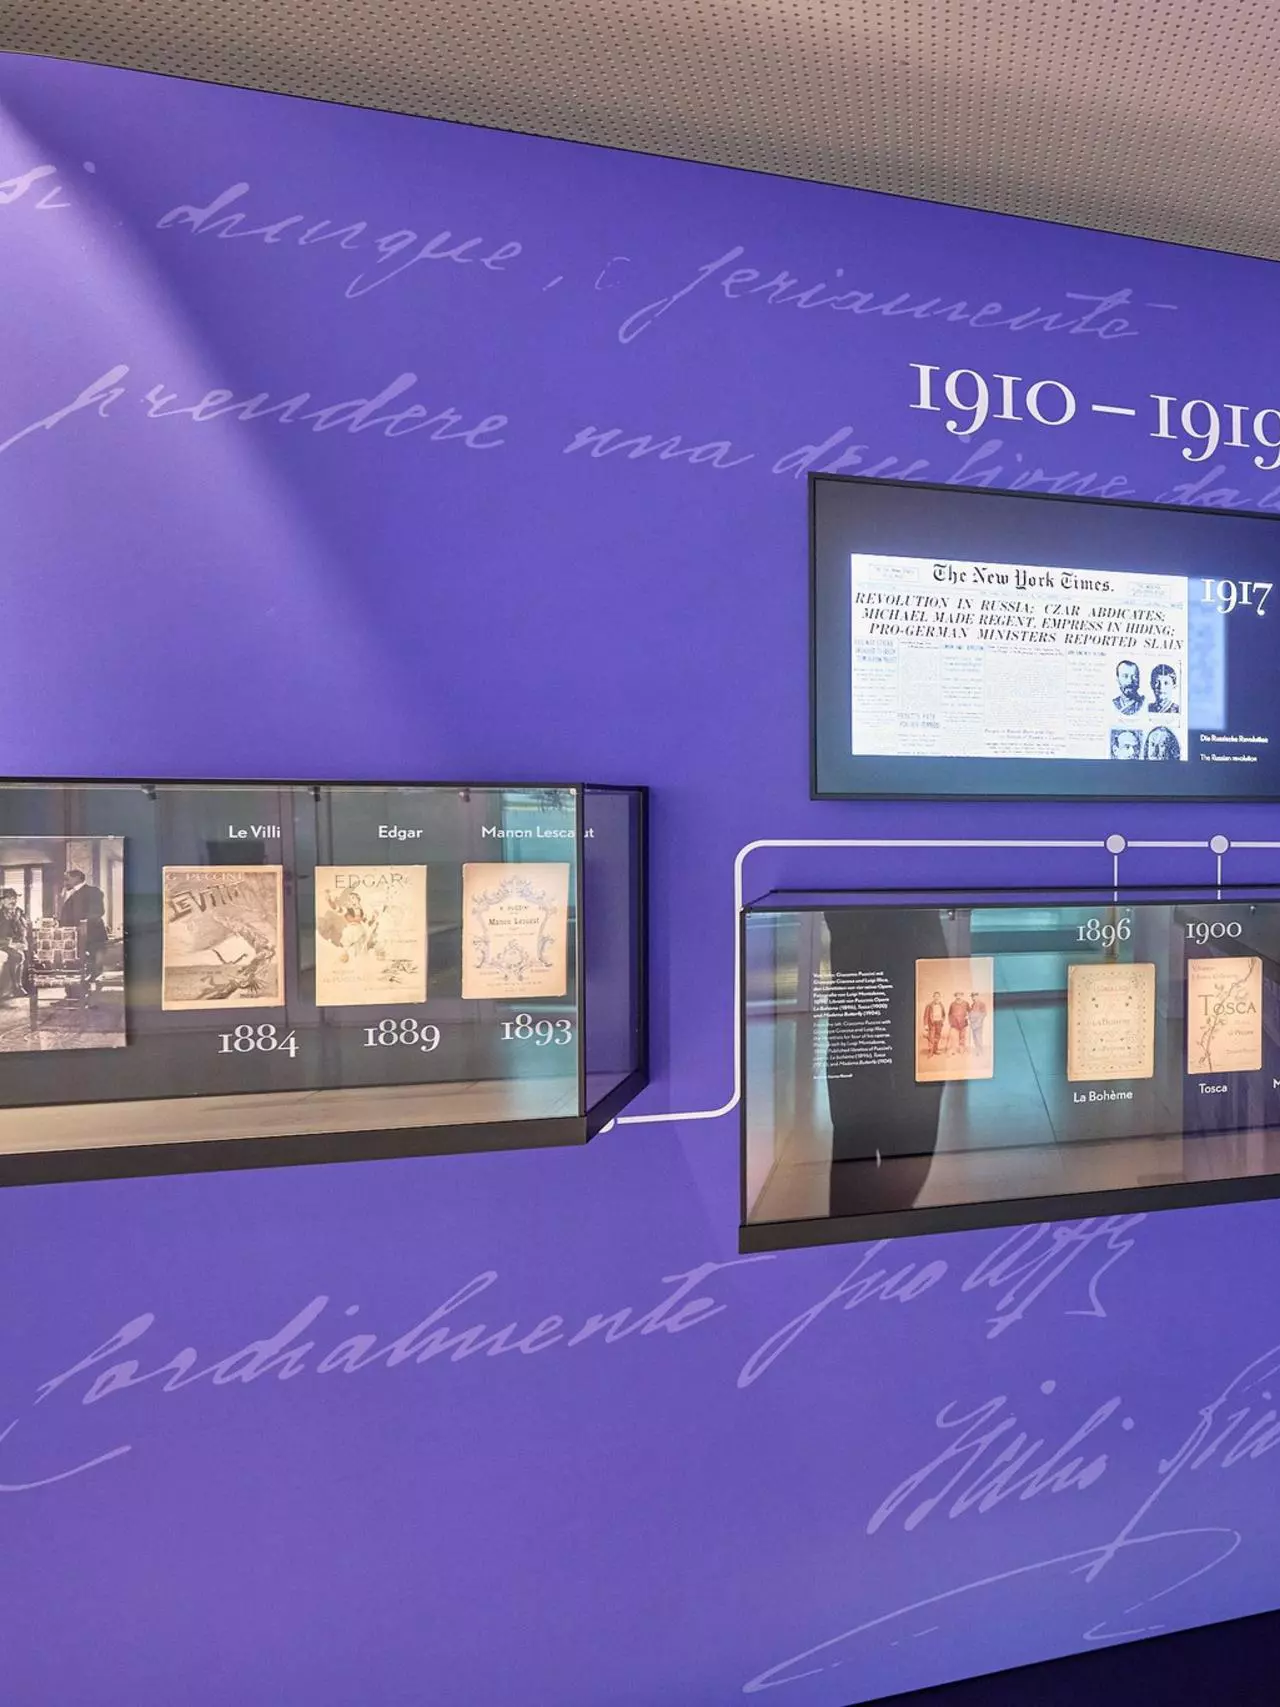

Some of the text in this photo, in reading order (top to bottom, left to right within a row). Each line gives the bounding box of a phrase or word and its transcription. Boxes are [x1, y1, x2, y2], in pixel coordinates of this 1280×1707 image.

[908, 362, 1077, 436] 1910
[932, 563, 968, 584] The
[972, 566, 1009, 585] New
[1014, 568, 1055, 590] York
[1060, 571, 1115, 593] Times.
[855, 591, 950, 609] REVOLUTION
[956, 598, 975, 610] IN
[1044, 602, 1081, 617] CZAR
[1201, 577, 1274, 617] 1917
[861, 607, 929, 623] MICHAEL
[932, 611, 976, 626] MADE
[1041, 617, 1105, 634] EMPRESS
[1107, 621, 1123, 633] IN
[868, 622, 970, 640] PRO-GERMAN
[976, 628, 1057, 644] MINISTERS
[1063, 633, 1138, 648] REPORTED
[1143, 638, 1185, 651] SLAIN
[227, 824, 281, 840] Le Villi
[378, 825, 423, 842] Edgar
[481, 825, 533, 839] Manon
[334, 873, 404, 889] EDGAR
[1075, 917, 1132, 947] 1896
[1185, 919, 1243, 944] 1900
[1197, 994, 1257, 1017] TOSCA
[217, 1022, 300, 1059] 1884
[363, 1017, 441, 1055] 1889
[500, 1012, 573, 1048] 1893
[1073, 1087, 1134, 1103] La Bohème
[1198, 1081, 1228, 1095] Tosca
